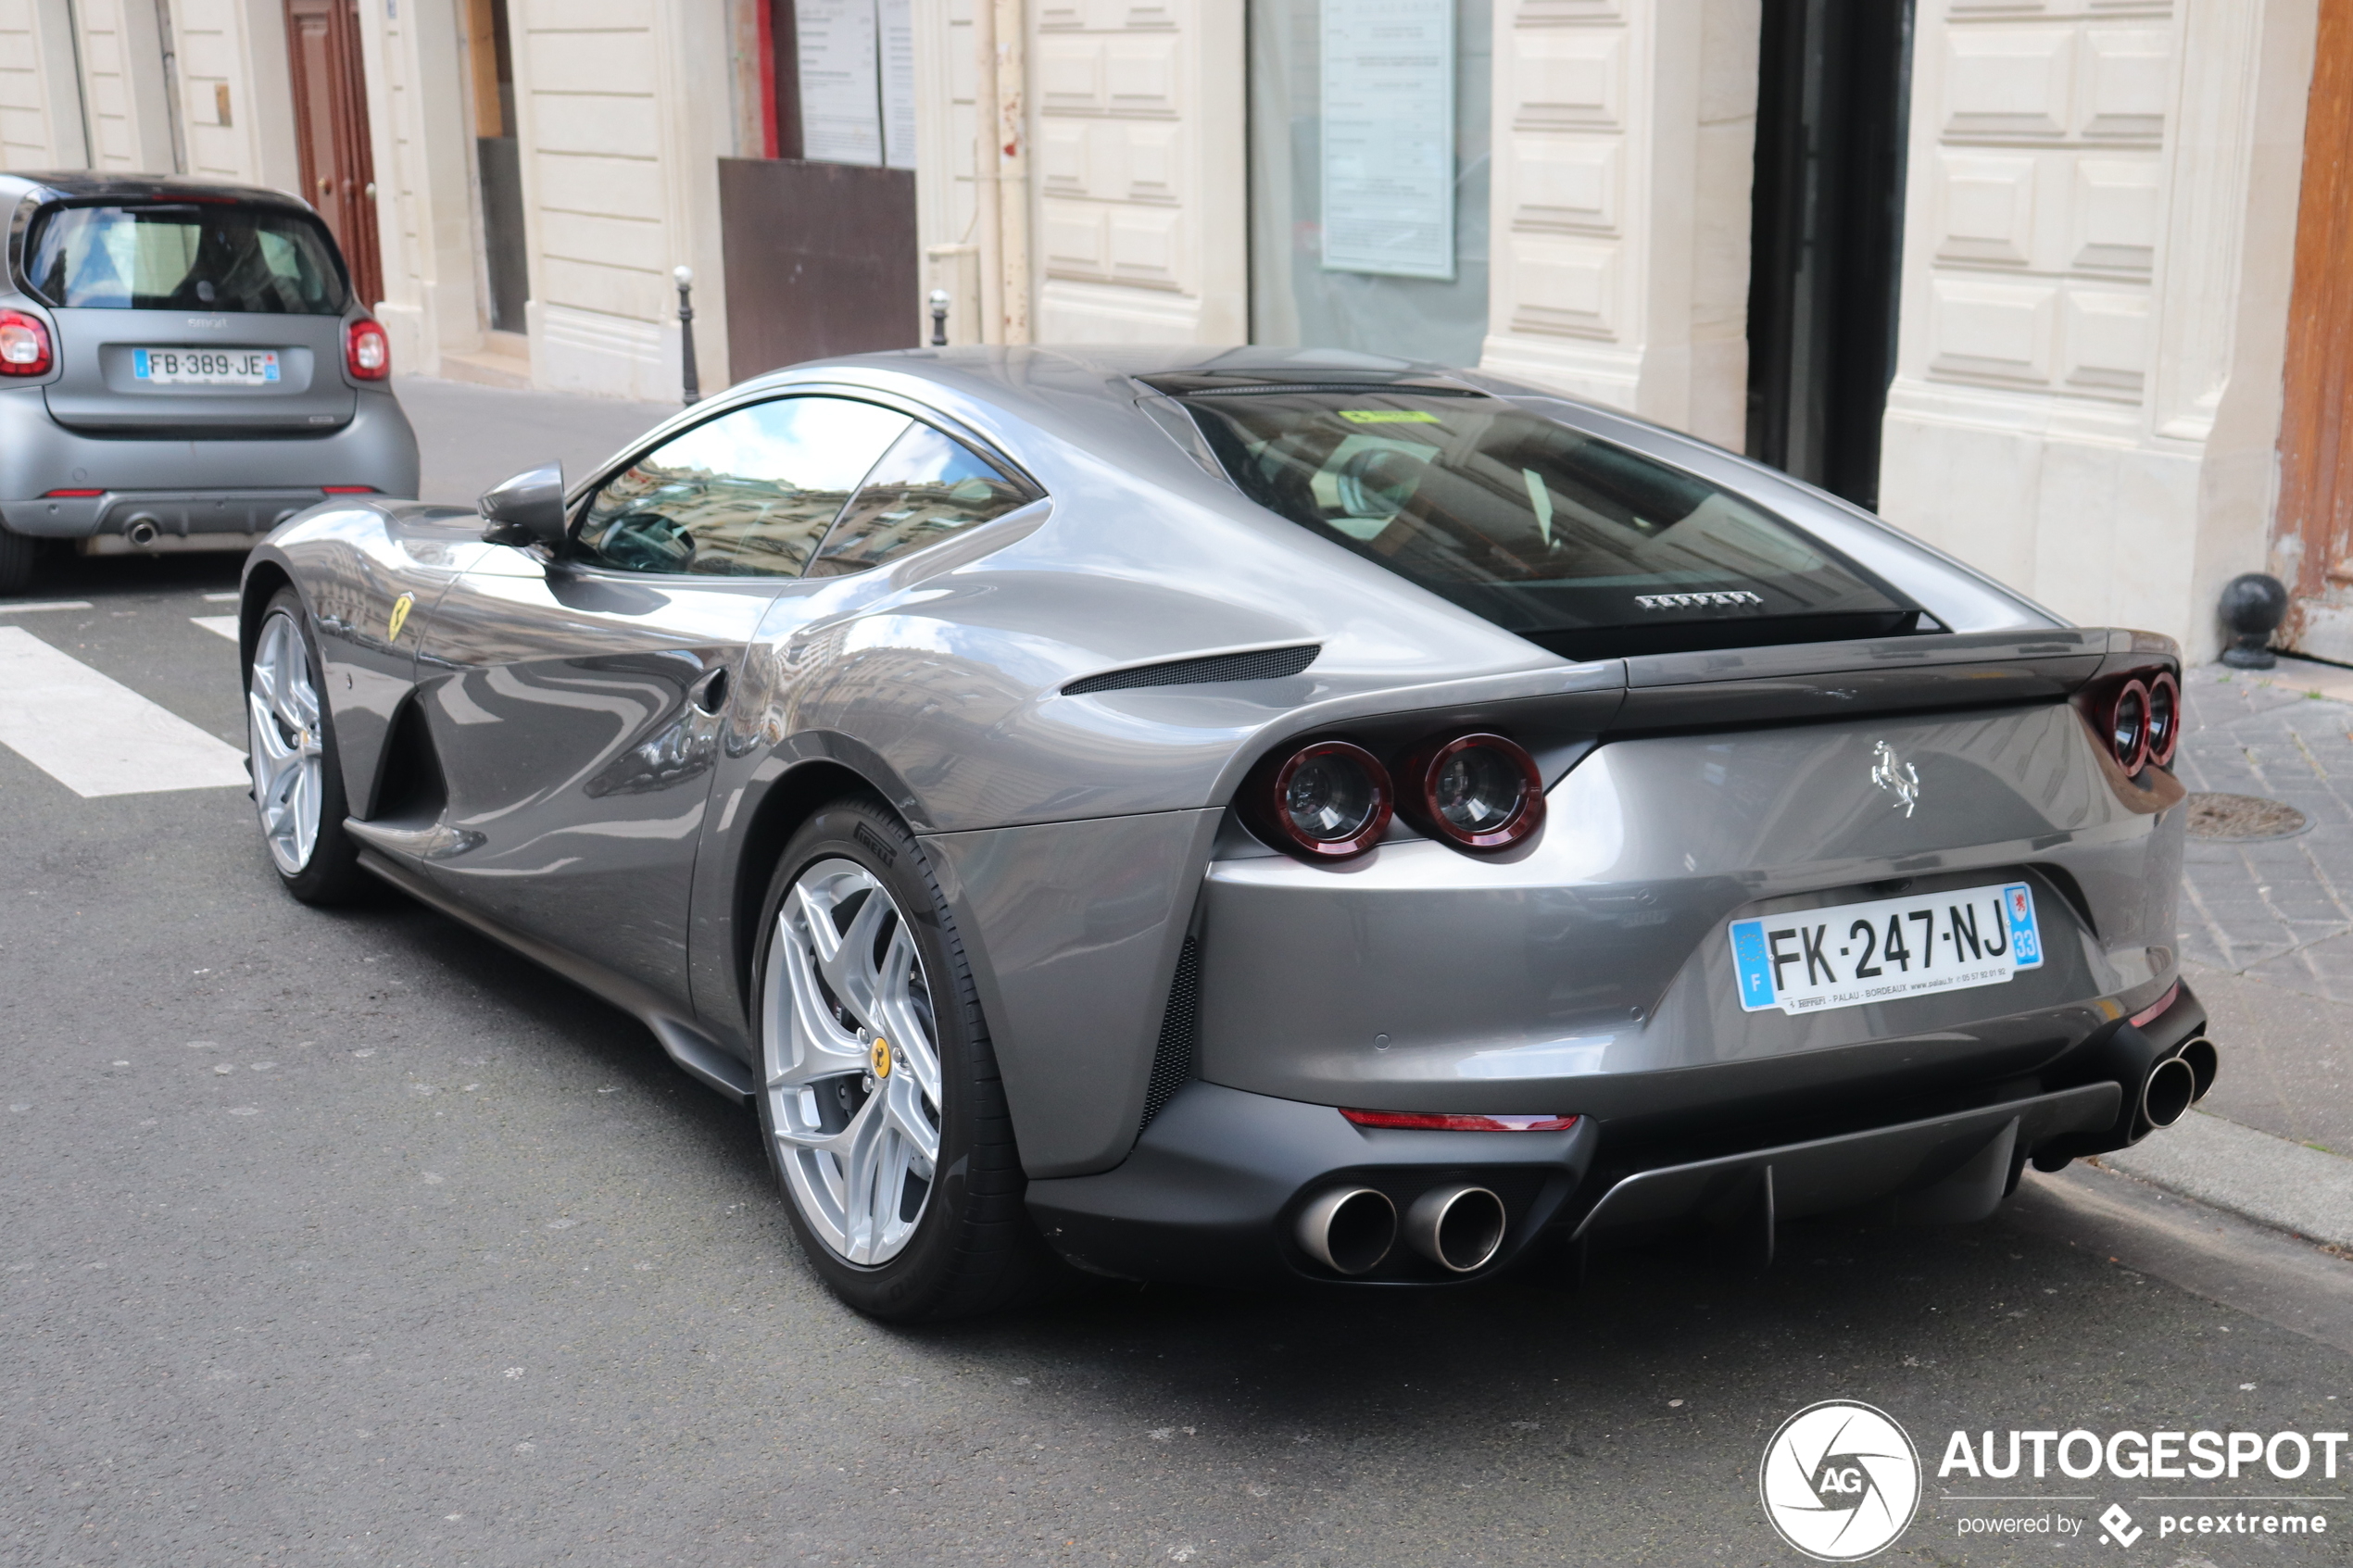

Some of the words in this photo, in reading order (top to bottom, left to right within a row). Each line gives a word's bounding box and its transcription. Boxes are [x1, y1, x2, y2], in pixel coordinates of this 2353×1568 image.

[188, 318, 228, 329] smart
[1635, 591, 1764, 608] Ferrari
[853, 821, 898, 869] PIRELLI
[2014, 929, 2036, 958] 33
[1751, 973, 1761, 992] F
[1797, 996, 1826, 1009] Ferrari
[1832, 991, 1860, 1003] PALAU
[1866, 984, 1907, 998] BORDEAUX
[1910, 977, 1954, 990] www.palau.fr
